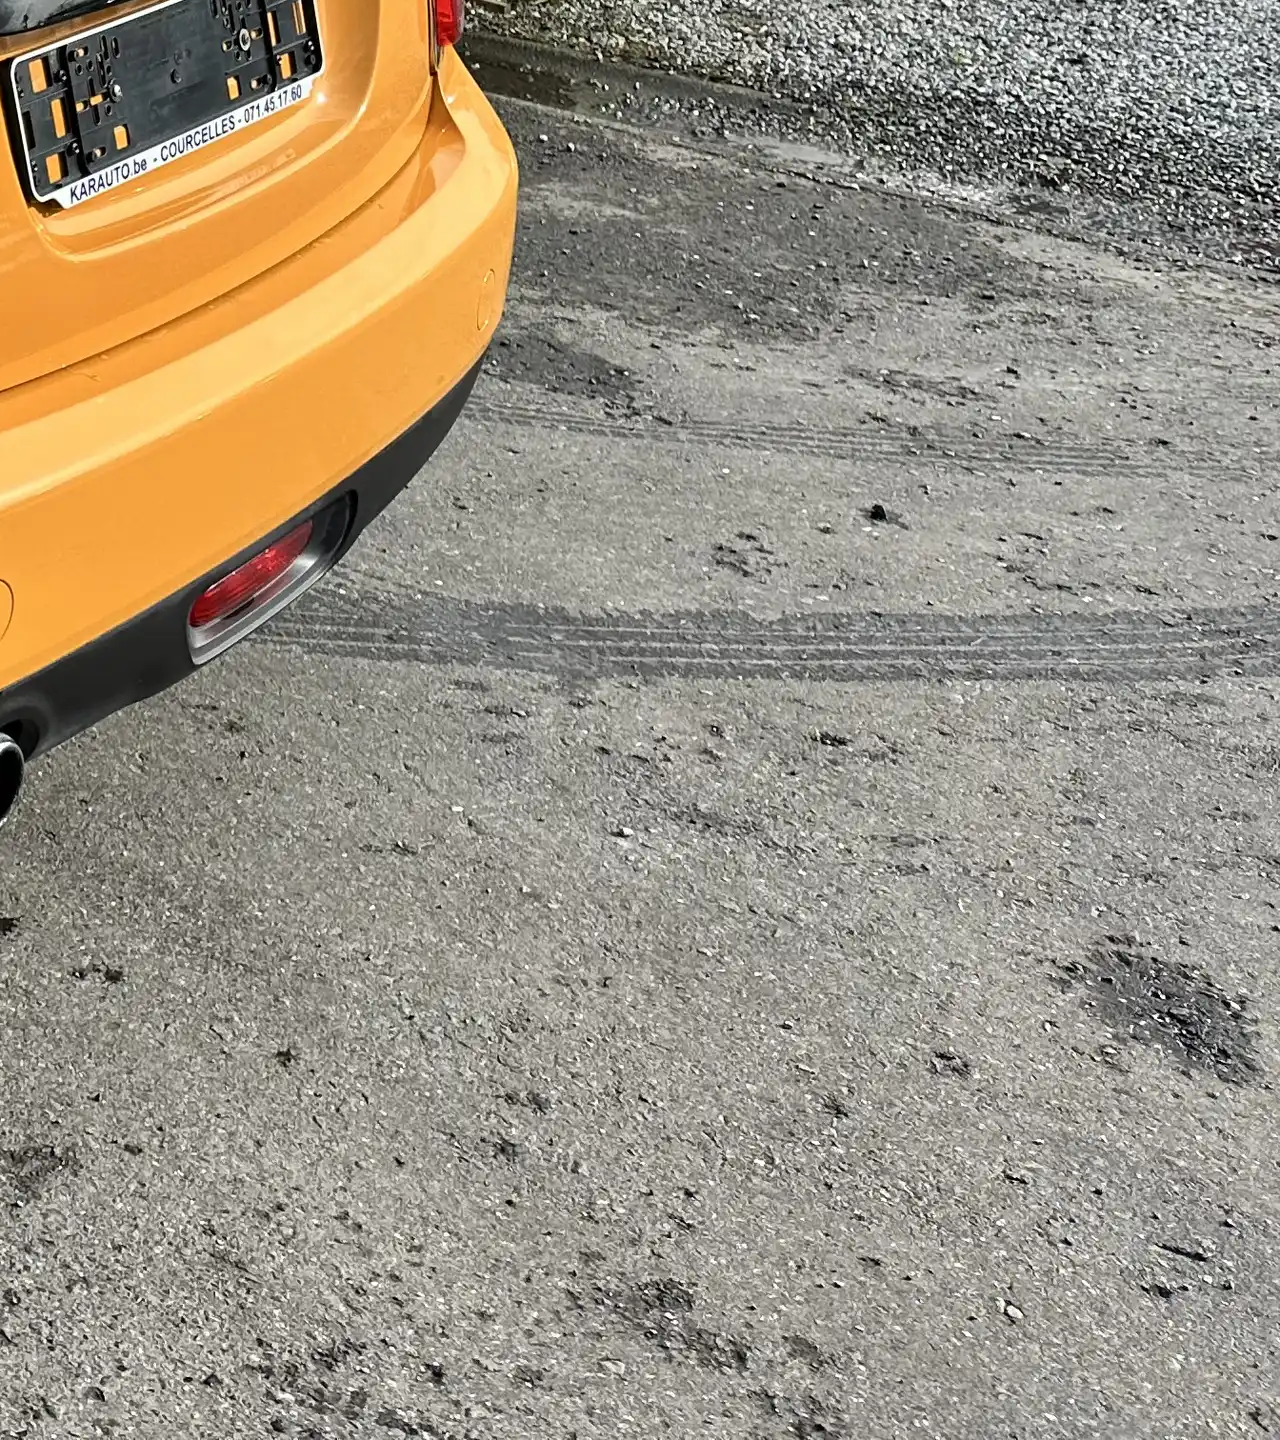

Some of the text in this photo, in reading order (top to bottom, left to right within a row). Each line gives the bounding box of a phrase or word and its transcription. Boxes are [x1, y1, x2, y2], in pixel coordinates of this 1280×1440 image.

[69, 158, 147, 204] KARAUTO.be
[160, 115, 236, 162] COURCELLES
[244, 83, 303, 124] 071.45.17.60
